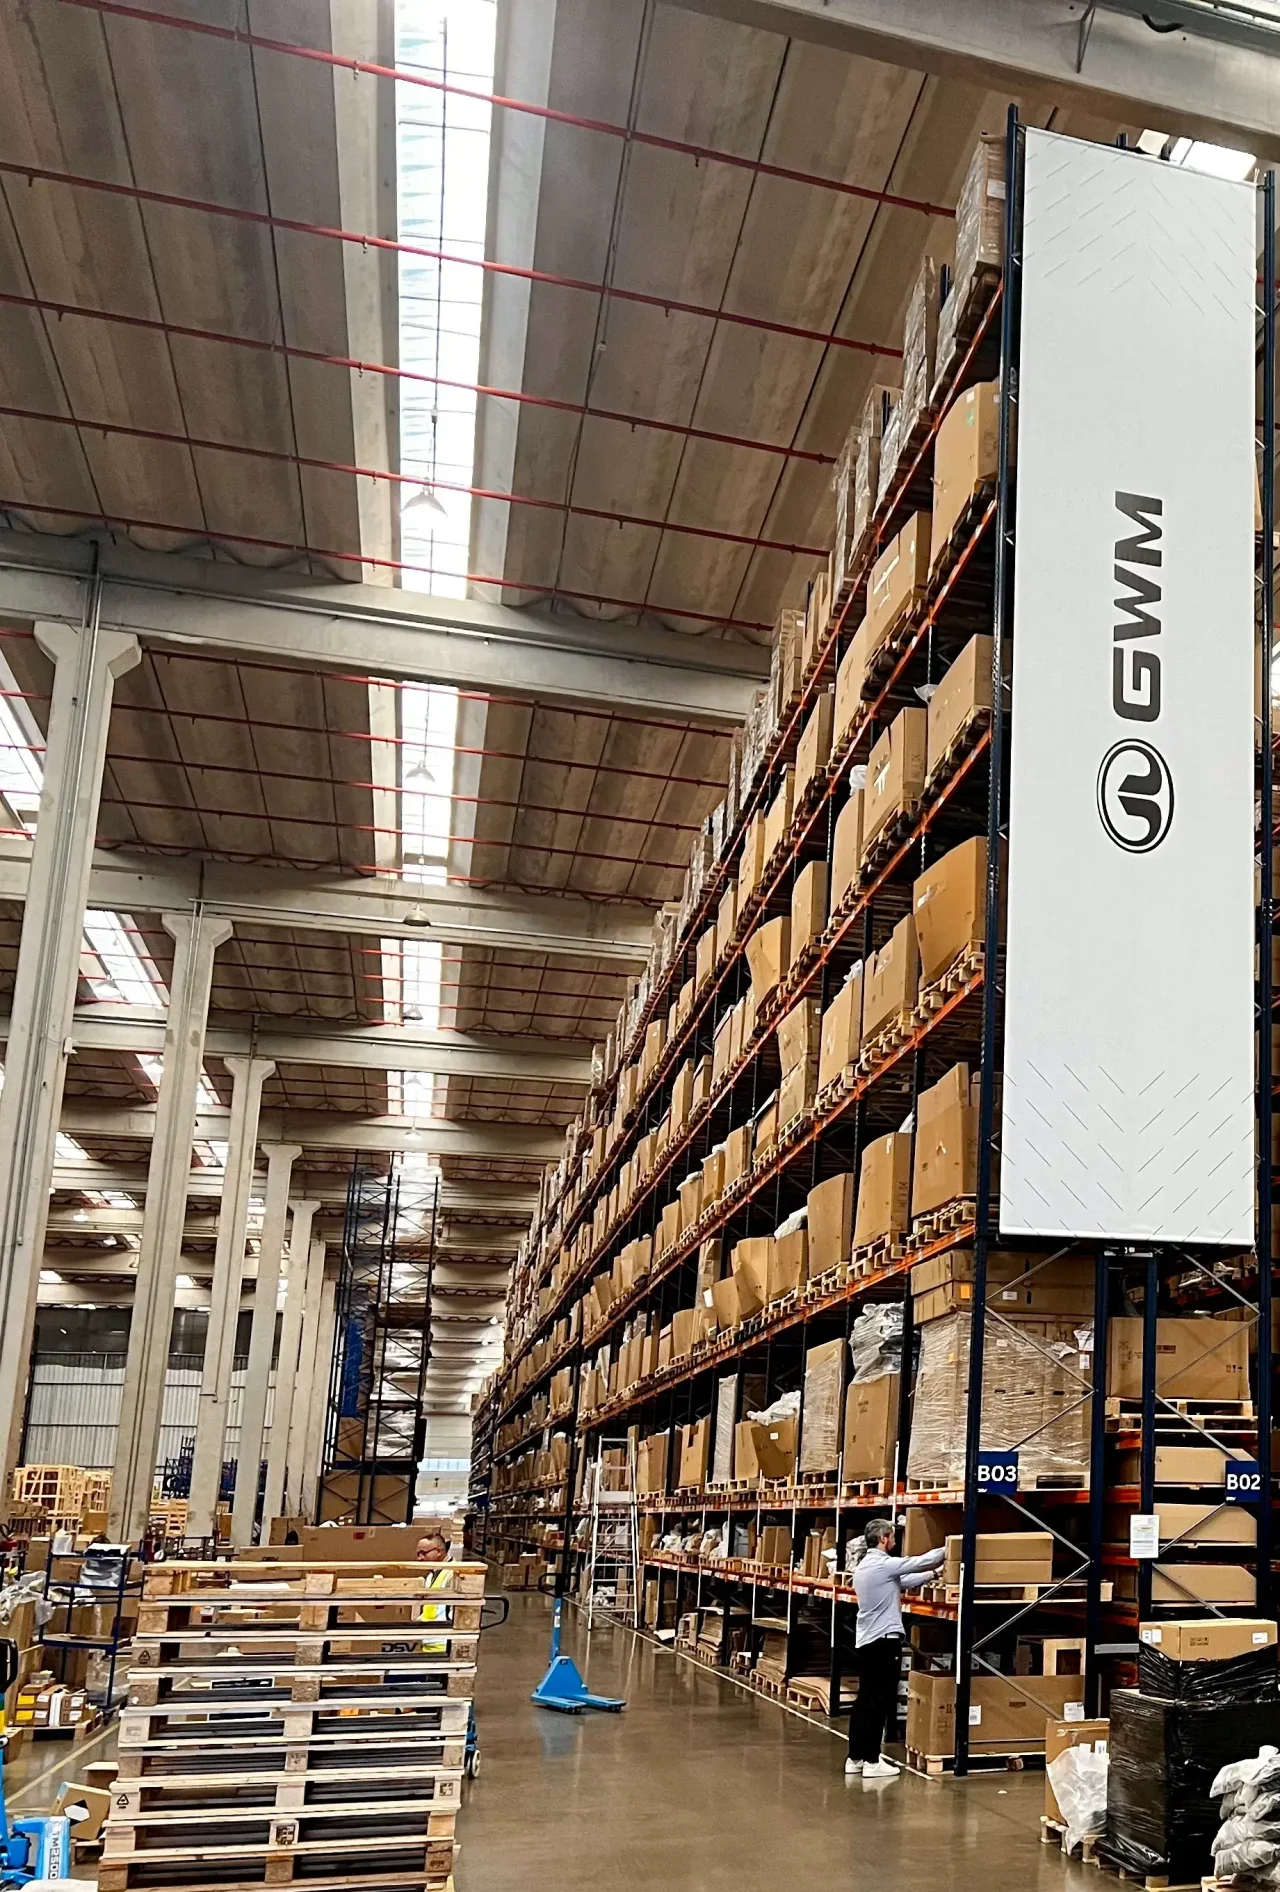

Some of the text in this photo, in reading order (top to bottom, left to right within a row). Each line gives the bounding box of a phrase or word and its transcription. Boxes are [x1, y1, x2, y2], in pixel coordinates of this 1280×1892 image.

[1112, 490, 1163, 723] GWM
[977, 1465, 1017, 1482] B03
[1226, 1473, 1261, 1490] B02
[381, 1642, 418, 1653] DSV
